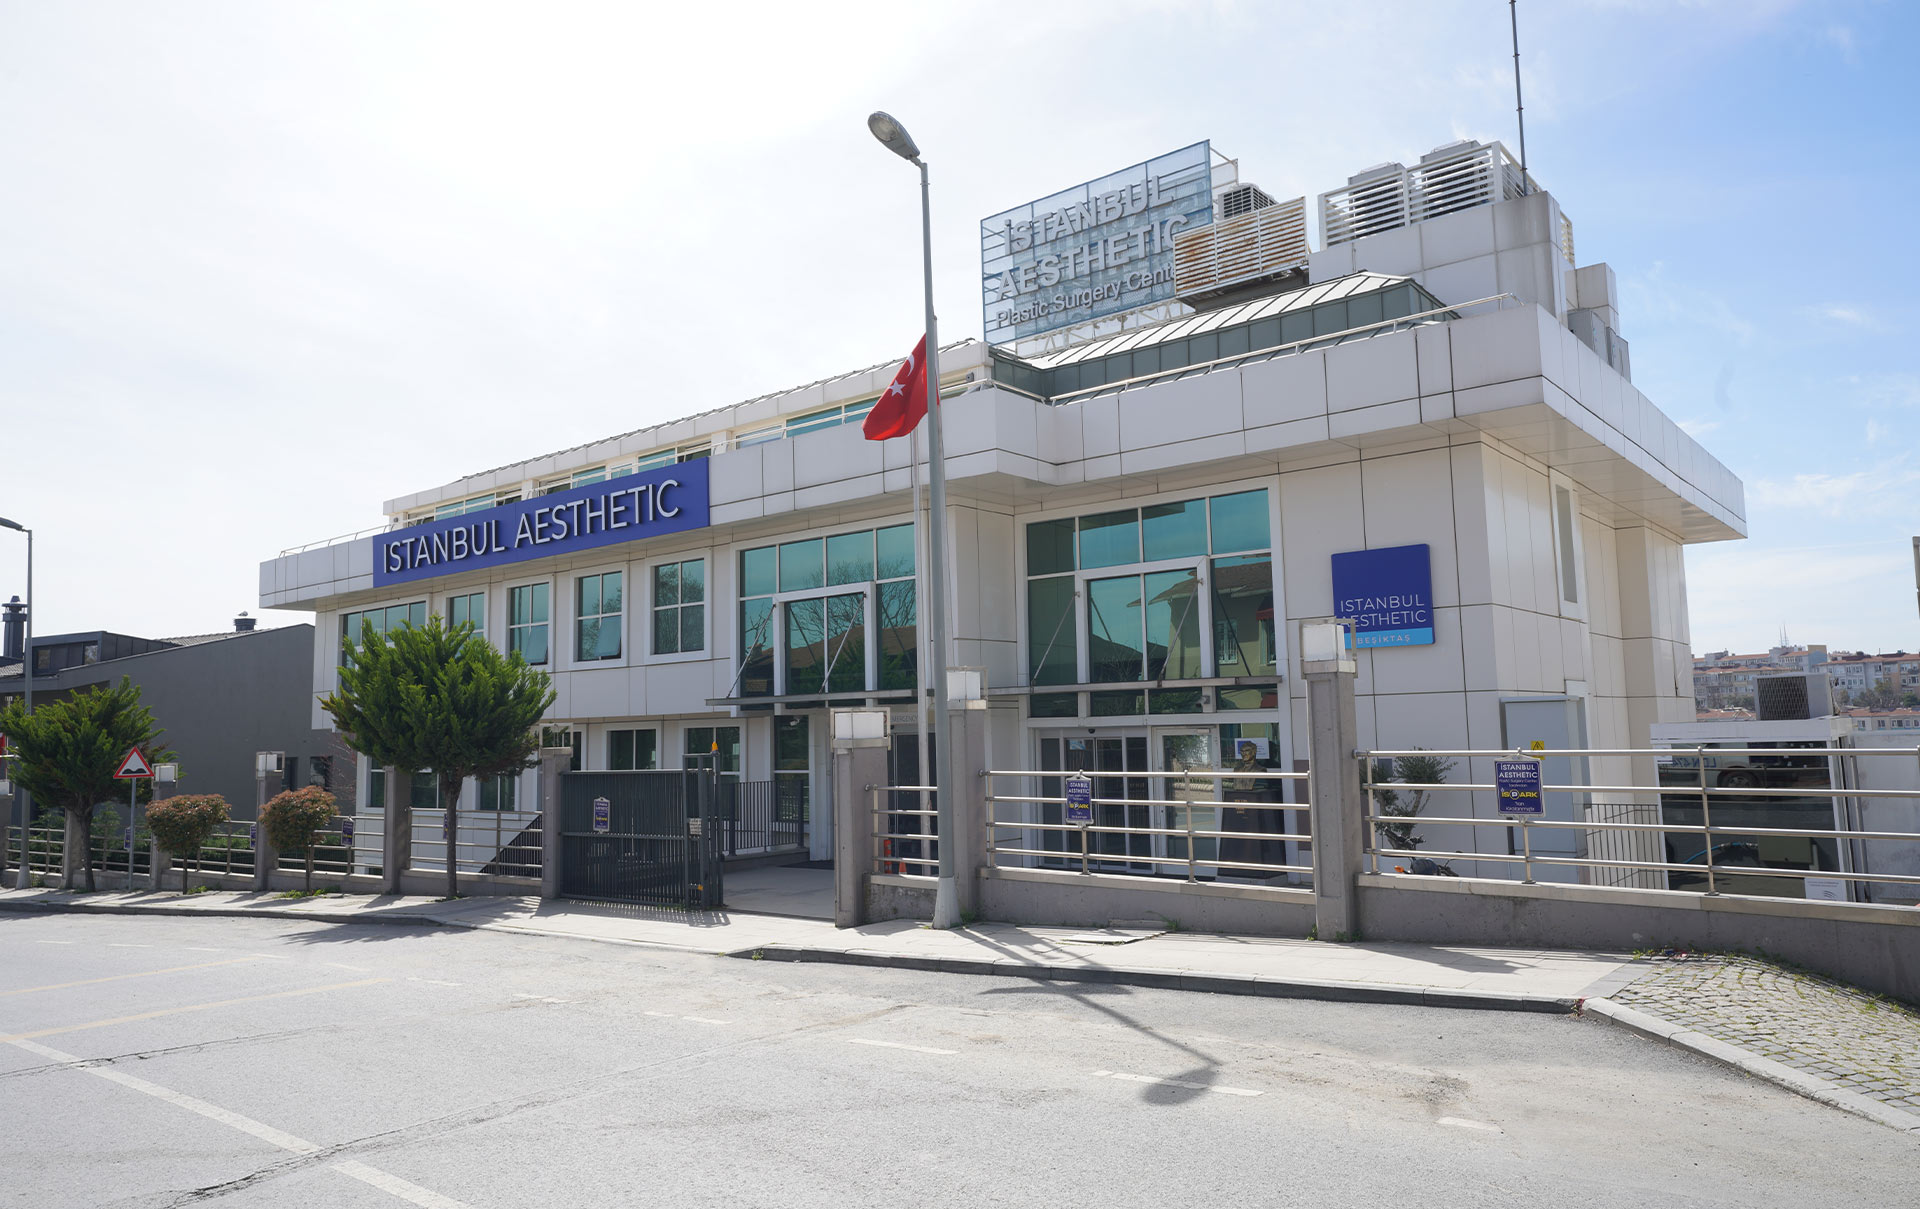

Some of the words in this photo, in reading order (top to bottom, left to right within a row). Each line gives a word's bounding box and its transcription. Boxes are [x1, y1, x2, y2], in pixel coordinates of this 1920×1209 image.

[1004, 175, 1174, 255] İSTANBUL
[995, 300, 1050, 329] Plastic
[1053, 279, 1122, 311] Surgery
[384, 518, 505, 574] ISTANBUL
[514, 479, 680, 549] AESTHETIC
[1340, 594, 1424, 612] ISTANBUL
[1357, 634, 1411, 646] BEŞİKTAŞ
